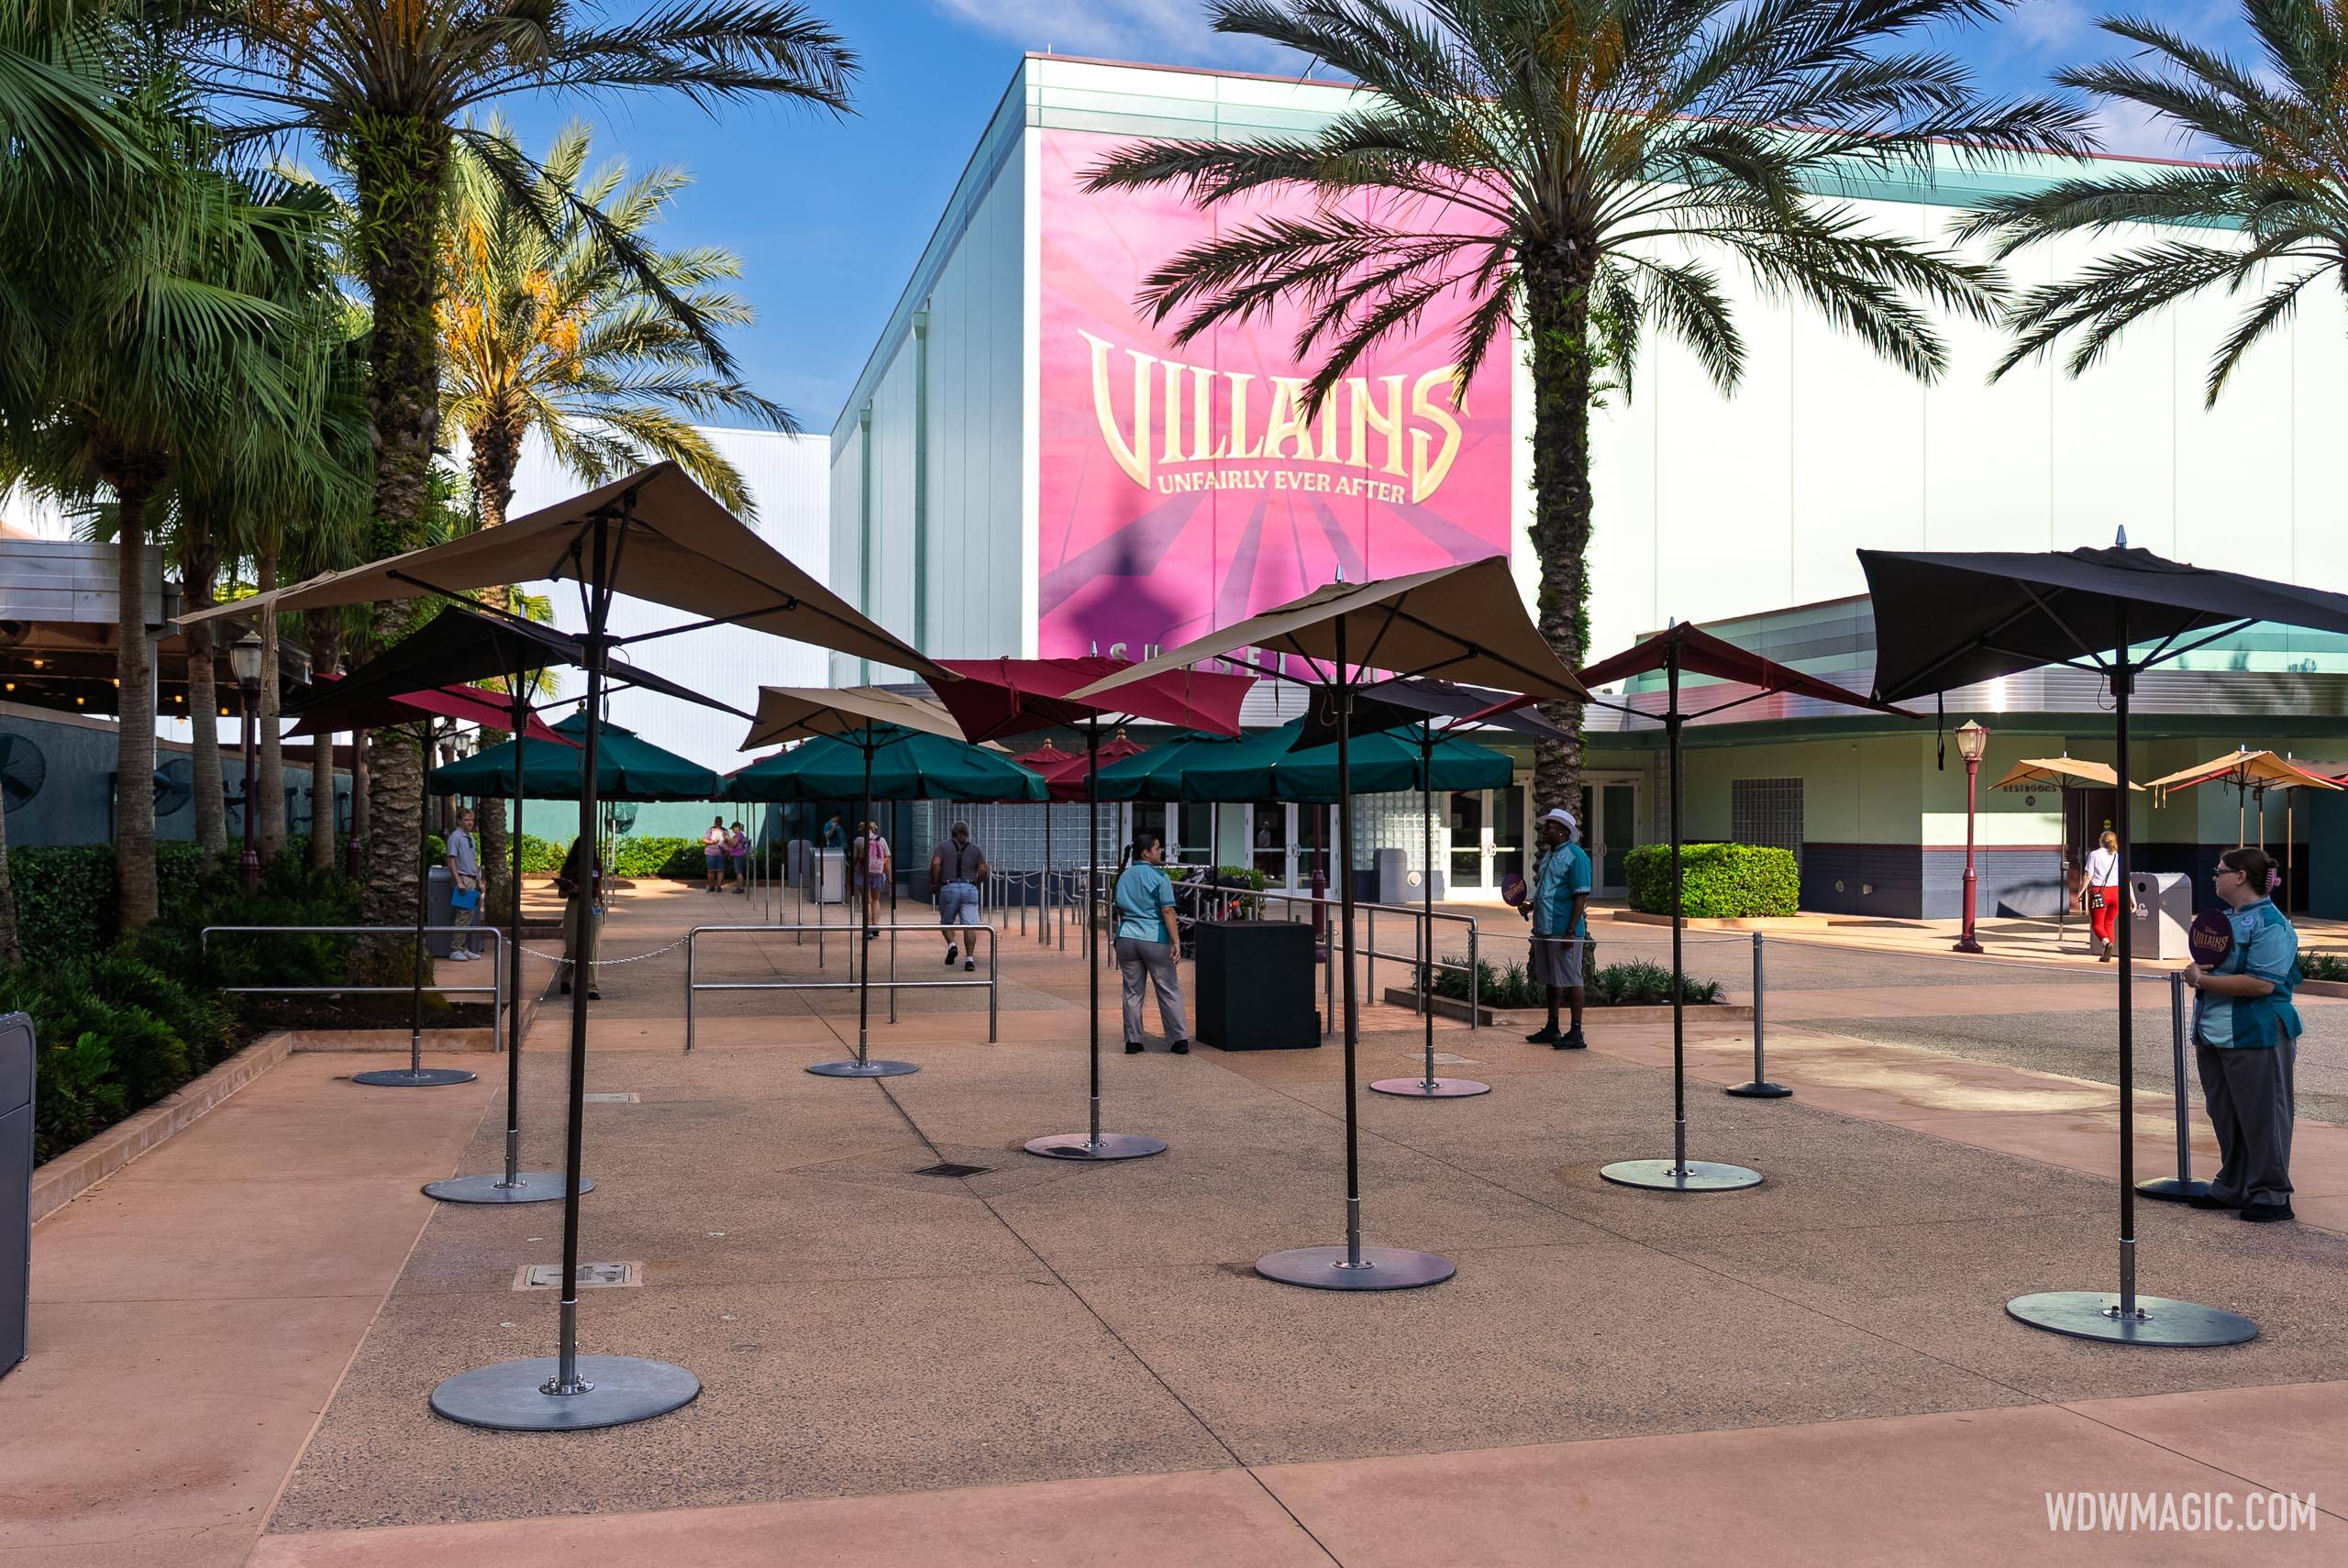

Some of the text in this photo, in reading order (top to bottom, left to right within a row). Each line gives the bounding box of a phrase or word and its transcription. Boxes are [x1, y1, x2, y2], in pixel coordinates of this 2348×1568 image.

[1078, 328, 1470, 505] VILLAINS
[1157, 469, 1407, 505] UNFAIRLY EVER AFTER
[2193, 928, 2229, 953] VILLAINS
